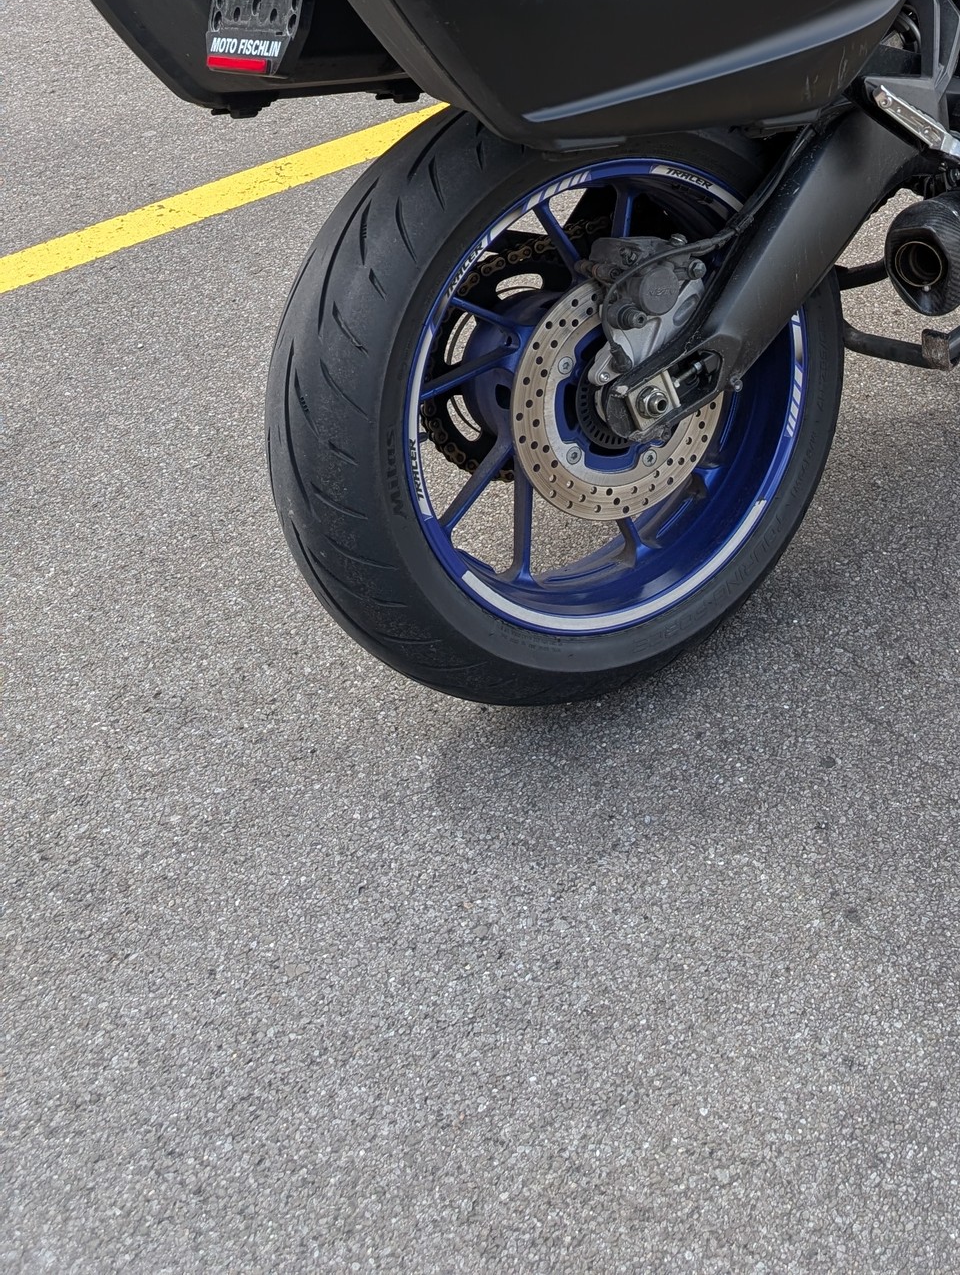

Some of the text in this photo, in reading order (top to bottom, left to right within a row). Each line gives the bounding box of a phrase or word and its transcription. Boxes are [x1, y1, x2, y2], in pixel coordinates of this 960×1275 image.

[210, 37, 282, 58] MOTO FISCHLIN
[666, 167, 713, 190] TRACER
[446, 240, 484, 298] TRACER
[408, 438, 424, 501] TRACER
